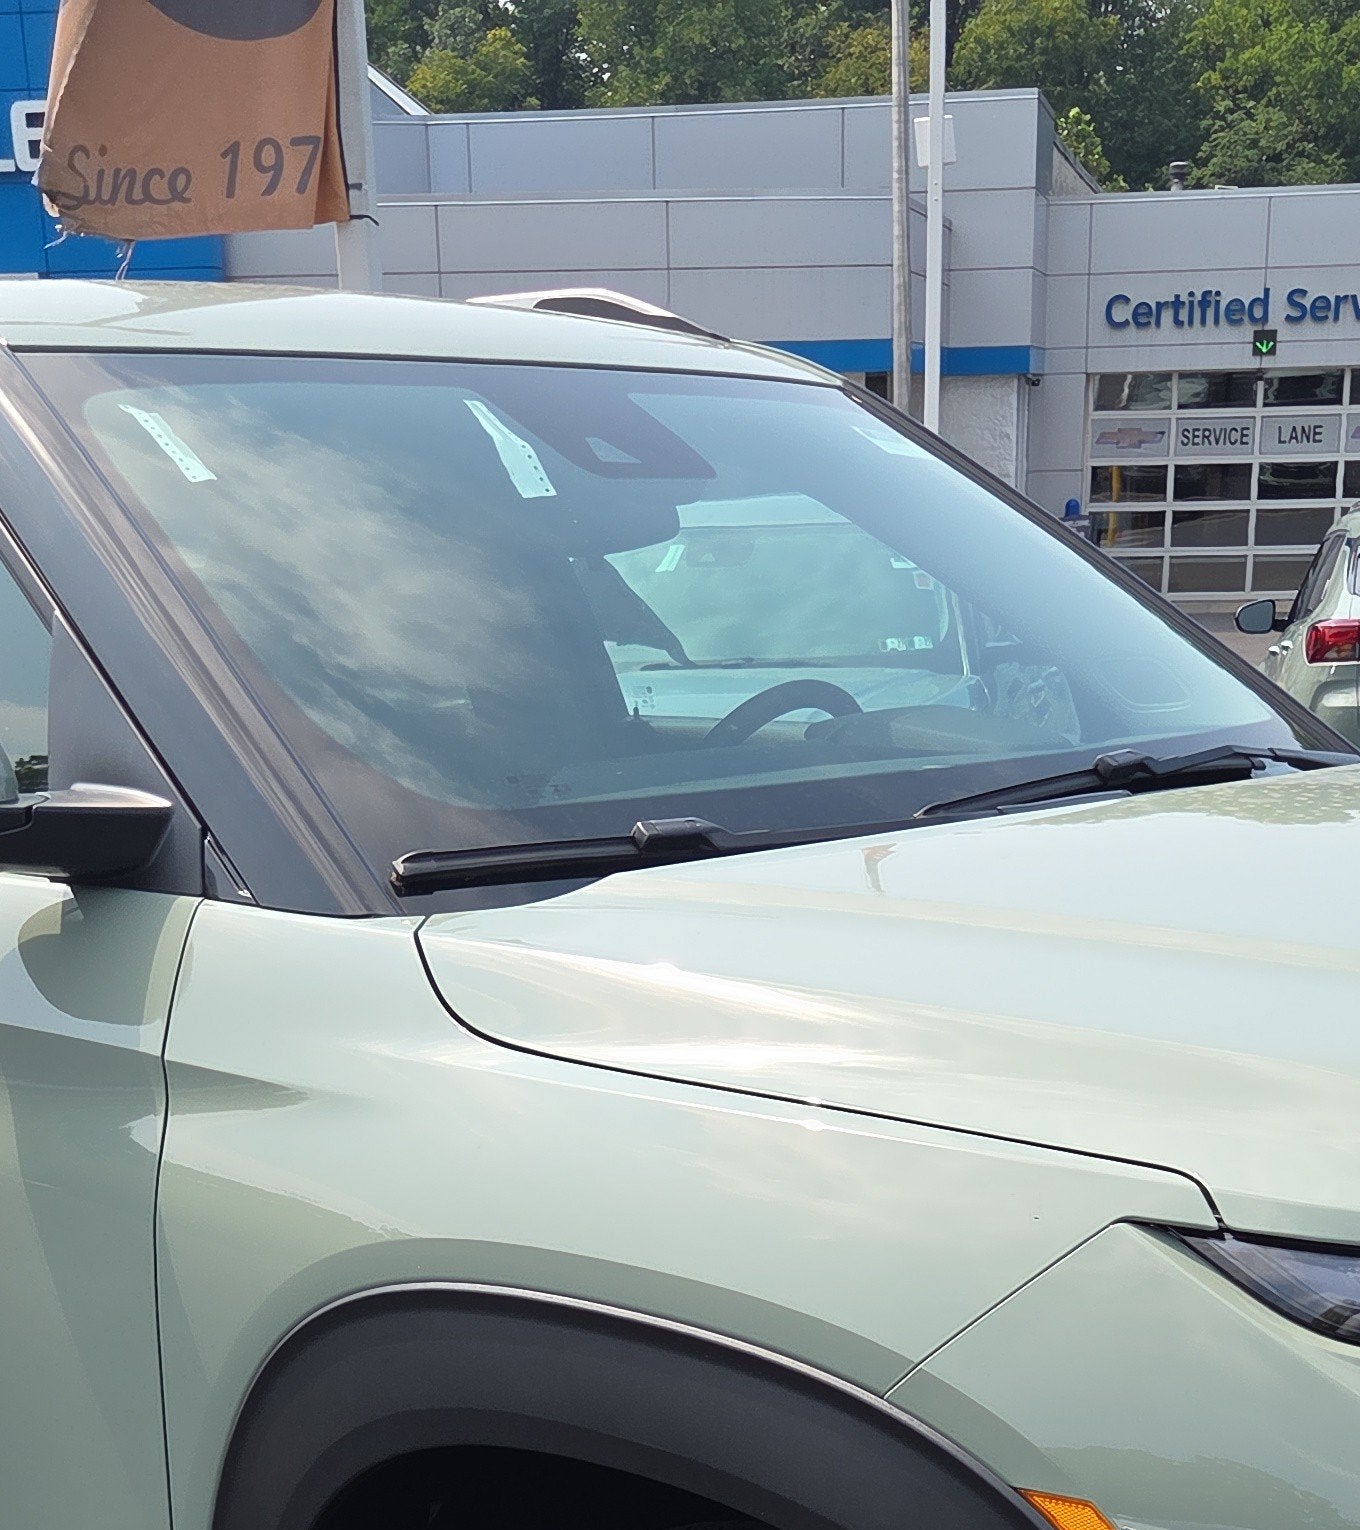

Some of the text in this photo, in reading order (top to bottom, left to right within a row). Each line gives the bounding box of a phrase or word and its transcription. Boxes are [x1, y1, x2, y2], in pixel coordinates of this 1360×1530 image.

[55, 135, 321, 211] Since 197
[1105, 287, 1270, 329] Certified
[1180, 424, 1324, 447] SERVICE LANE
